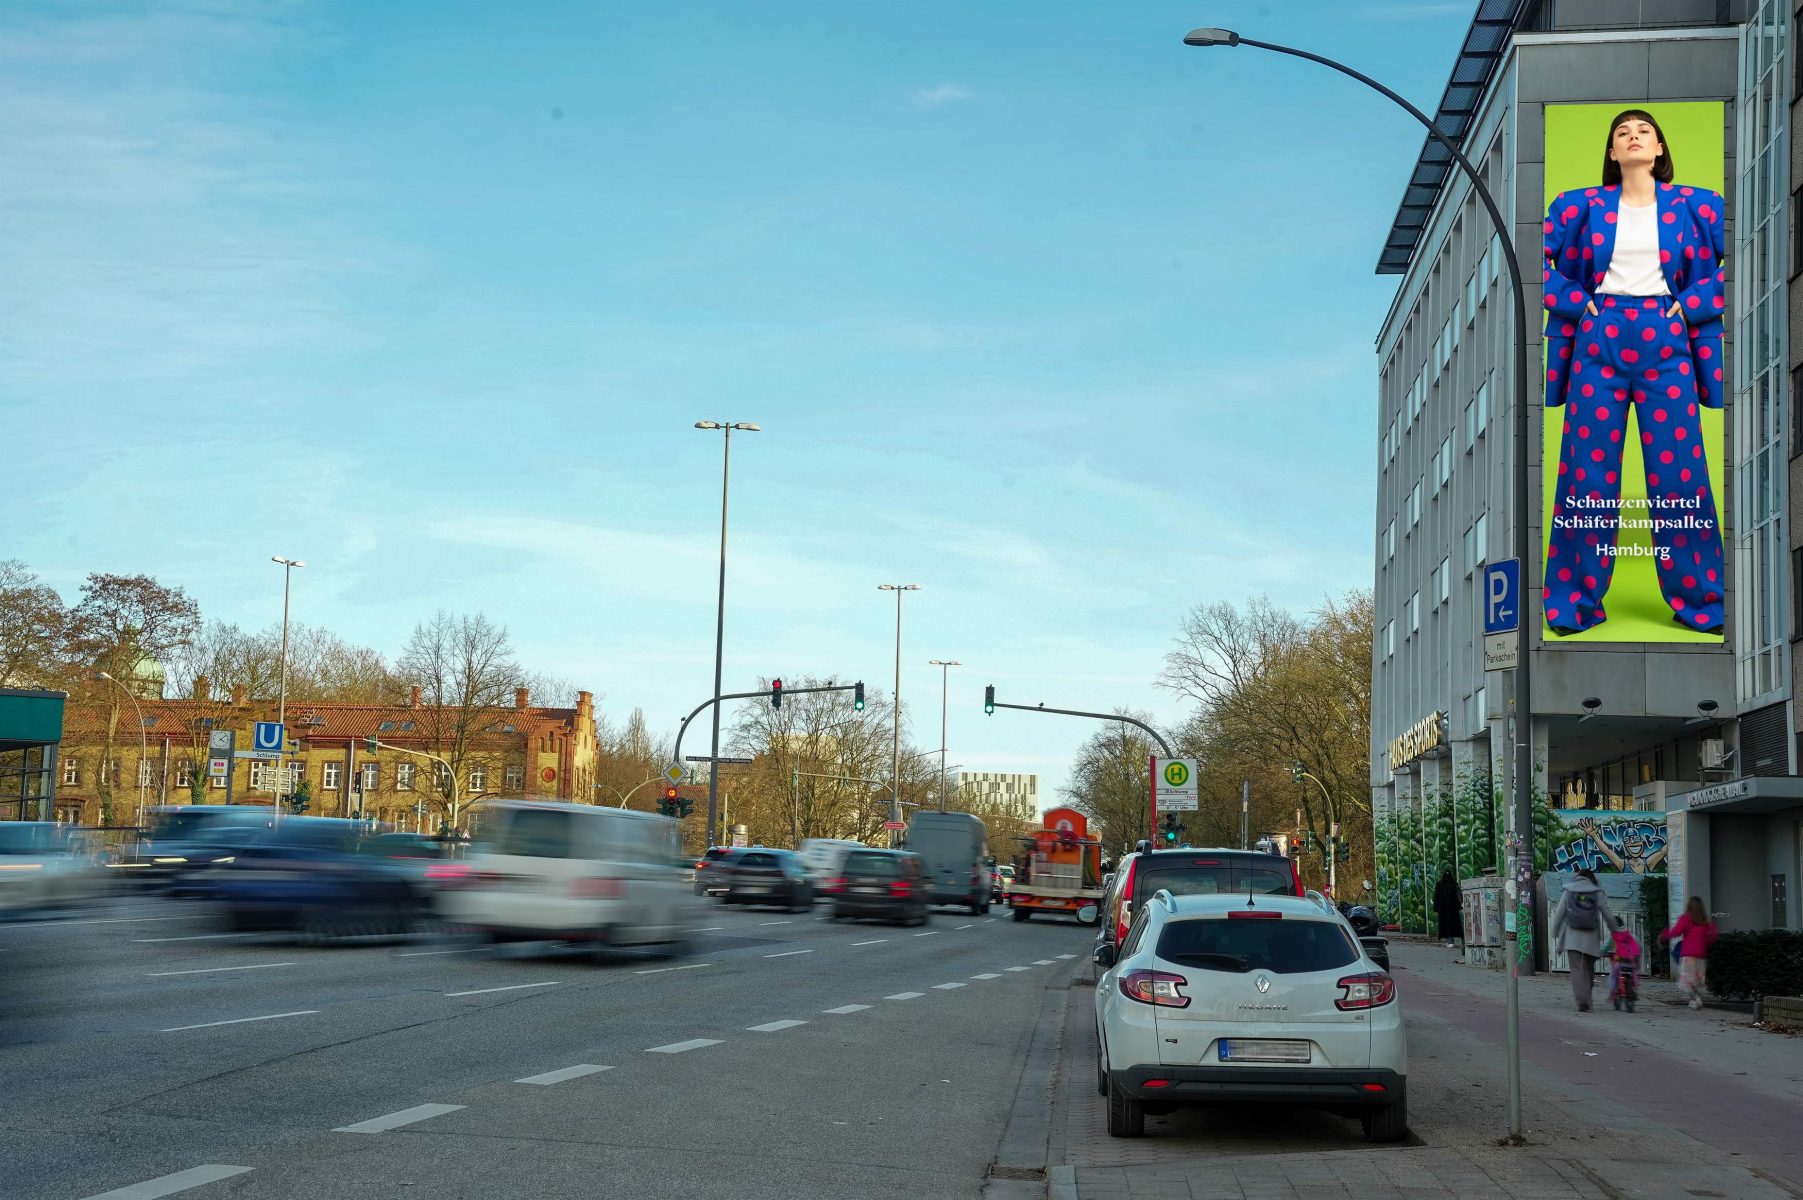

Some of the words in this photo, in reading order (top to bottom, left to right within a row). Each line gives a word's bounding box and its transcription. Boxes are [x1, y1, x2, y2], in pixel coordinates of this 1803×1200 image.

[1565, 495, 1701, 509] Schanzenviertel
[1553, 515, 1714, 533] Schäferkampsallee
[1596, 543, 1671, 560] Hamburg
[1489, 570, 1509, 624] P
[1496, 641, 1506, 650] mit
[1486, 652, 1516, 665] Parkschein
[260, 724, 279, 748] U
[1171, 768, 1182, 780] H
[1553, 822, 1668, 873] HAMB
